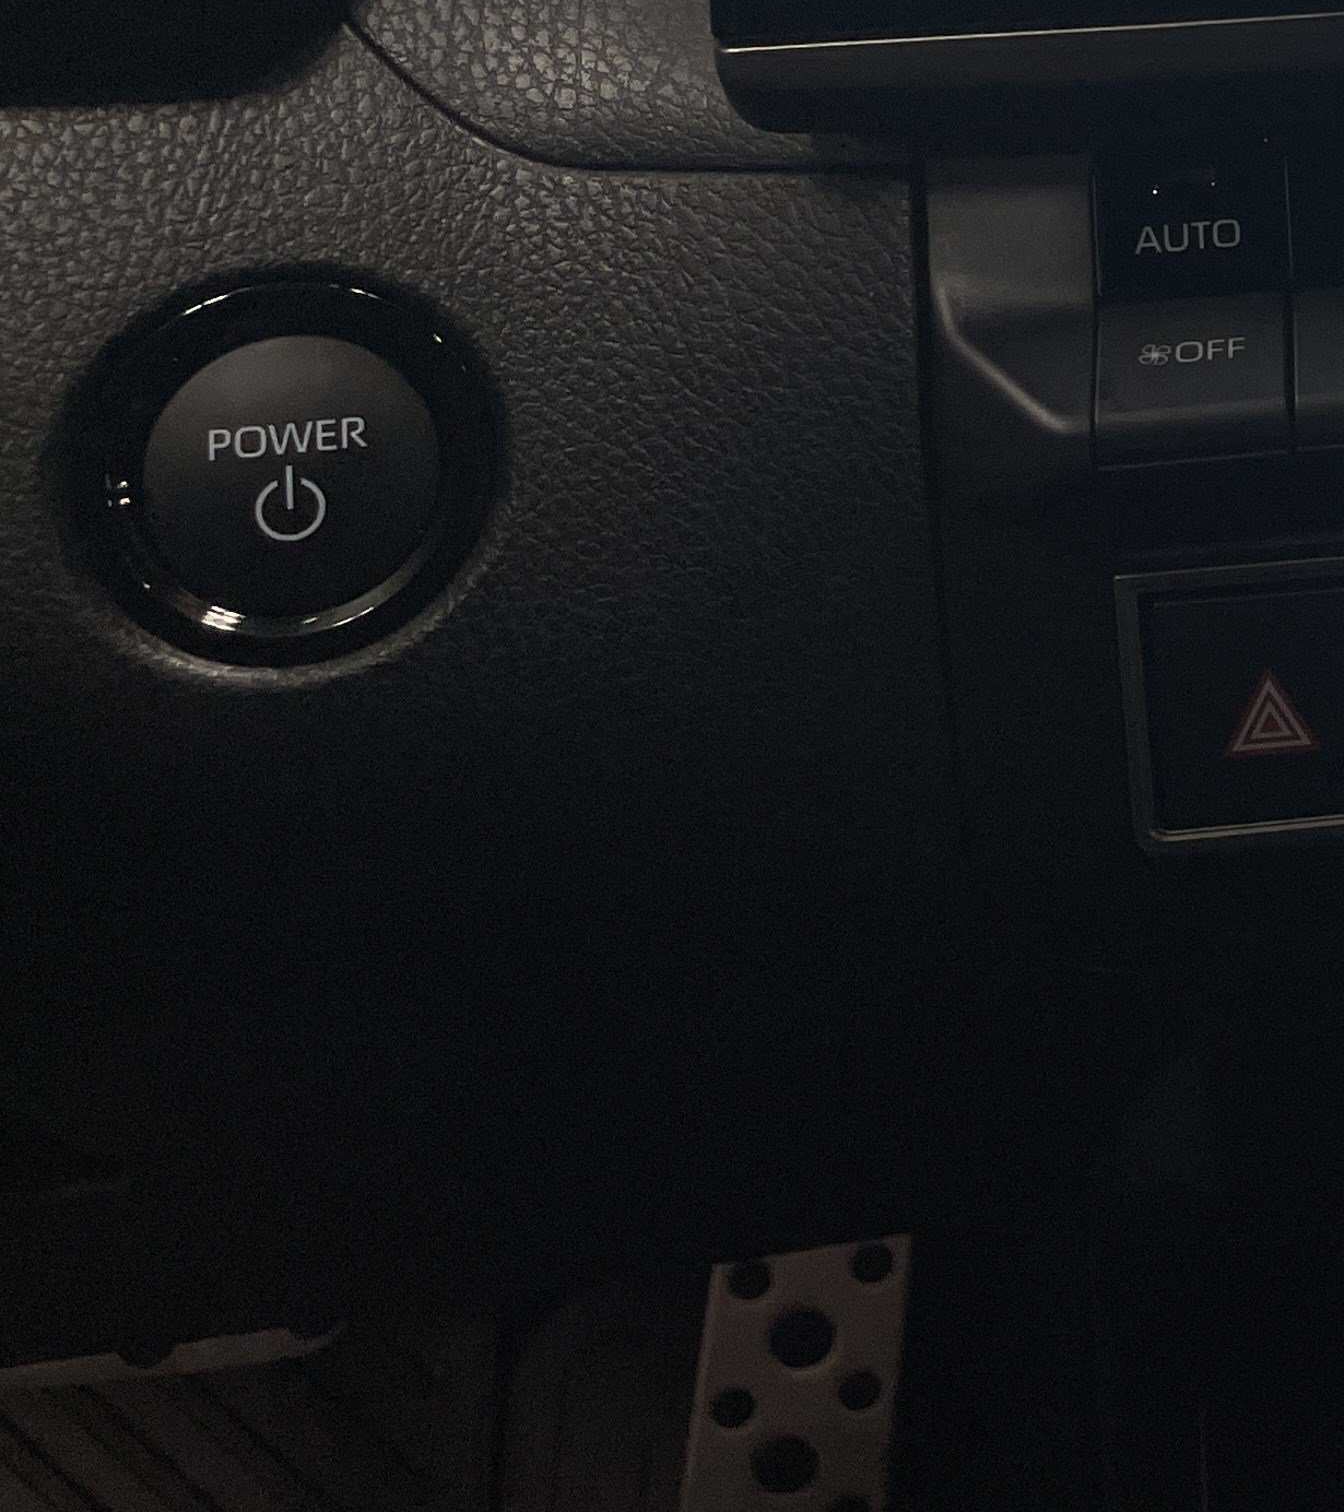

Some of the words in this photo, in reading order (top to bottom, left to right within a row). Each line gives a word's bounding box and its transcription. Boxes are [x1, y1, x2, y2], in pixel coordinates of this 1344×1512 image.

[1135, 218, 1242, 255] AUTO
[1175, 337, 1246, 364] OFF
[207, 416, 368, 462] POWER
